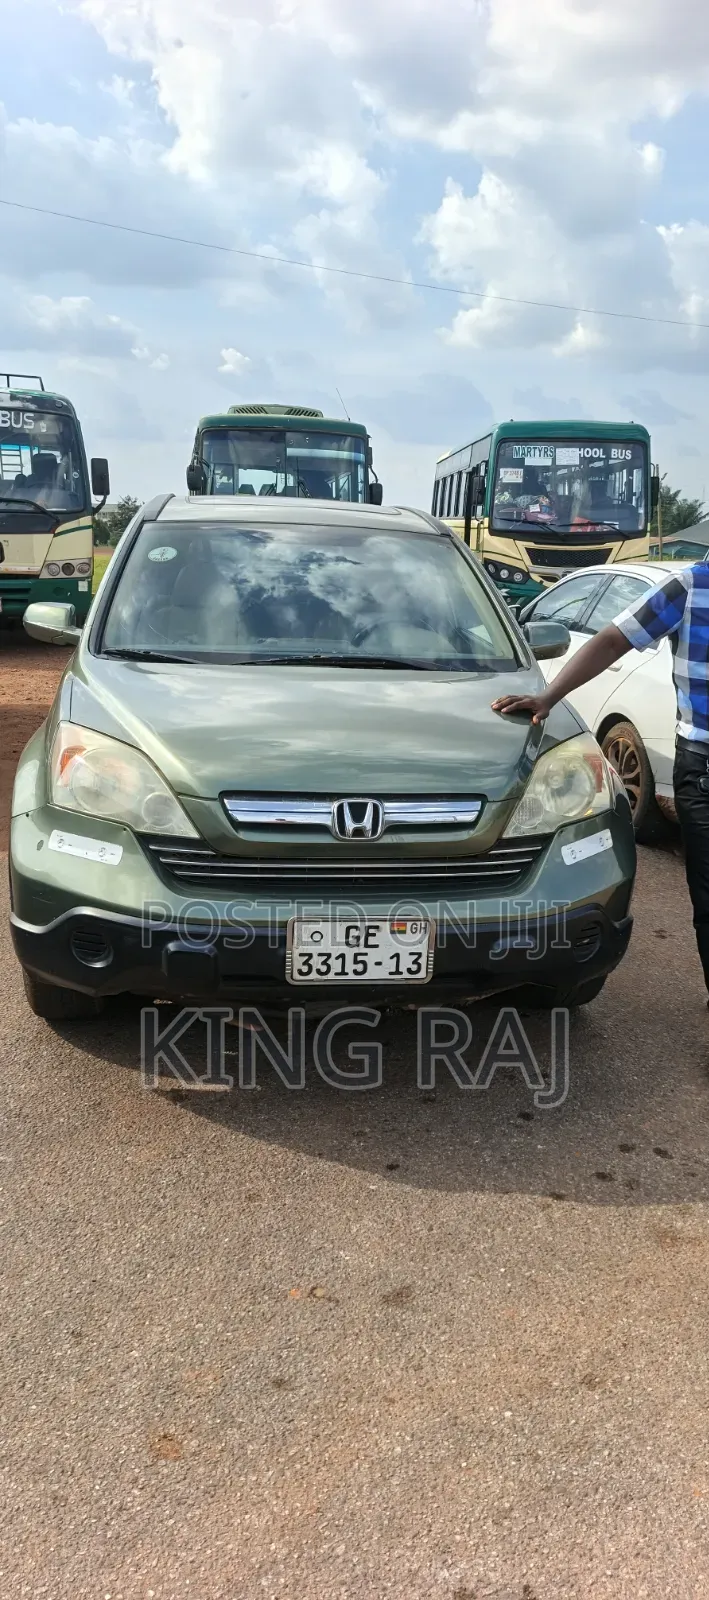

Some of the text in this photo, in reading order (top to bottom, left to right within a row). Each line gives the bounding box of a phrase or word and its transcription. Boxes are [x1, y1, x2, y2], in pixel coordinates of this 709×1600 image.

[0, 410, 35, 429] BUS
[513, 445, 555, 459] MARTYRS
[611, 448, 632, 460] BUS
[344, 922, 428, 949] GE GH
[296, 951, 423, 976] 3315-13
